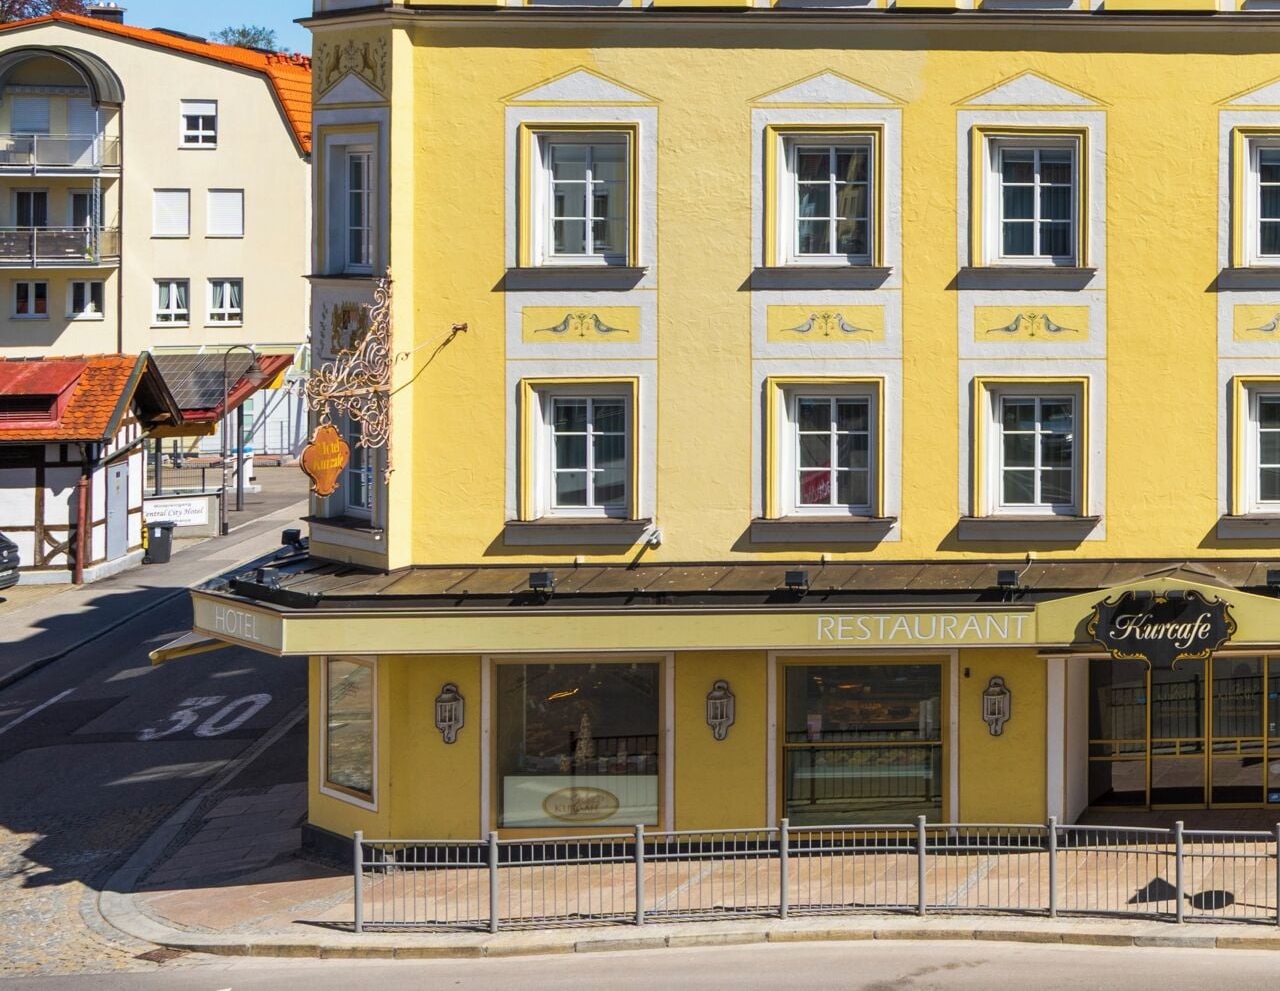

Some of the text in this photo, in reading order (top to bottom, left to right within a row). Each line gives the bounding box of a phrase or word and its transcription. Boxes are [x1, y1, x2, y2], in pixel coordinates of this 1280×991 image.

[215, 606, 259, 640] HOTEL
[817, 615, 1029, 641] RESTAURANT
[1109, 612, 1212, 650] Kurcafe
[136, 693, 273, 741] 30
